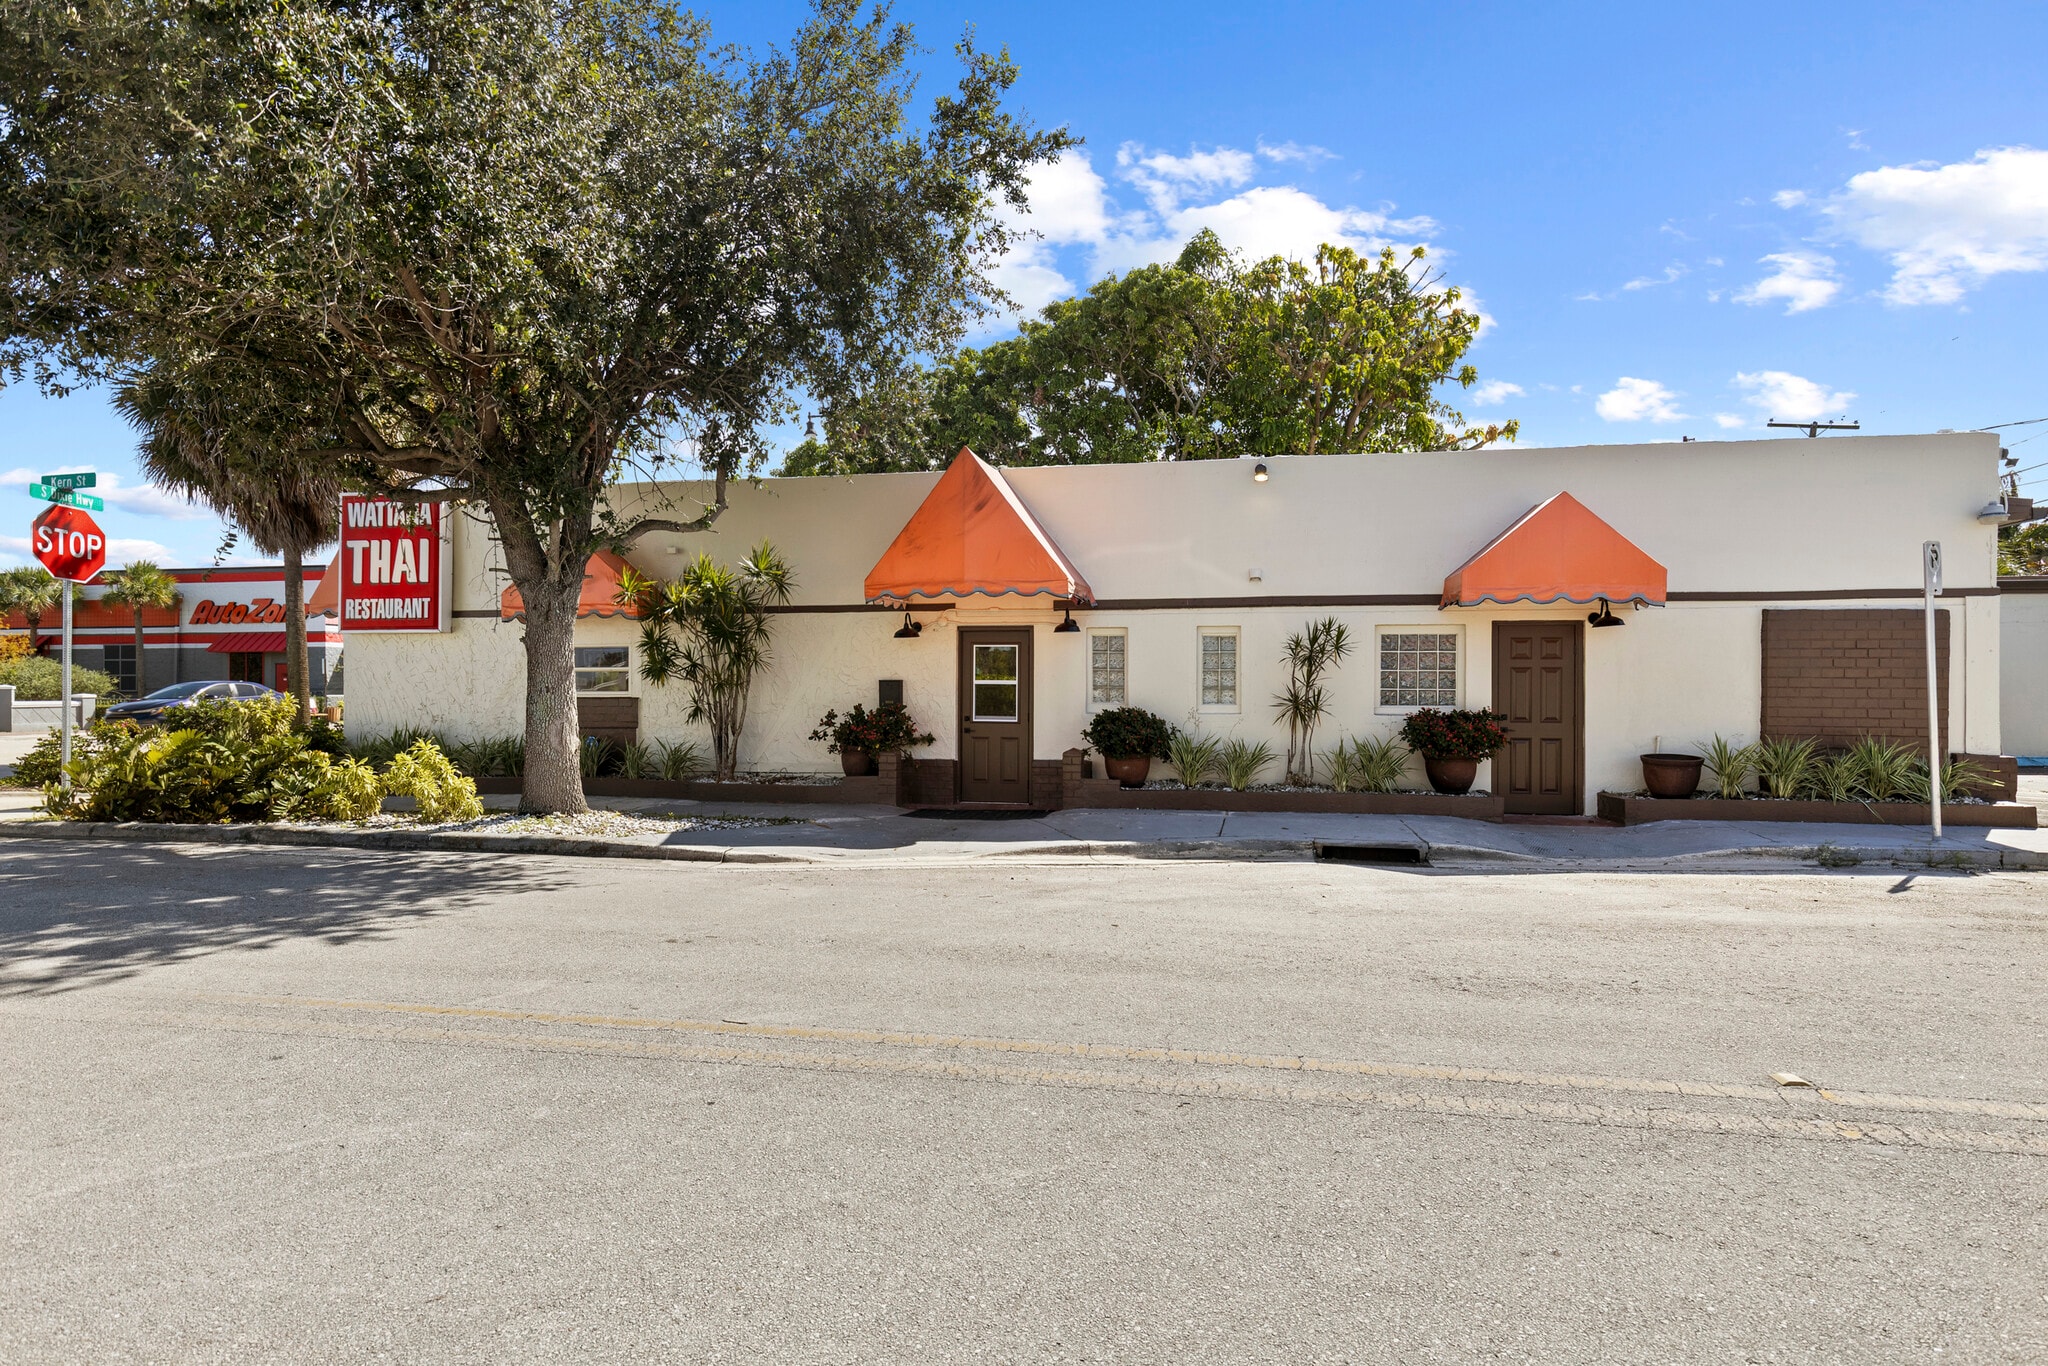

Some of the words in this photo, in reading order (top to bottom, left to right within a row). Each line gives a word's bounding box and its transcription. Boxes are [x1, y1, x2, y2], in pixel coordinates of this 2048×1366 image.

[50, 477, 72, 487] Kern
[76, 475, 86, 486] St
[41, 486, 47, 497] S
[76, 493, 94, 509] Hwy
[36, 526, 102, 560] STOP
[346, 538, 430, 584] THAI
[189, 598, 309, 624] AutoZo
[345, 598, 431, 619] RESTAURANT
